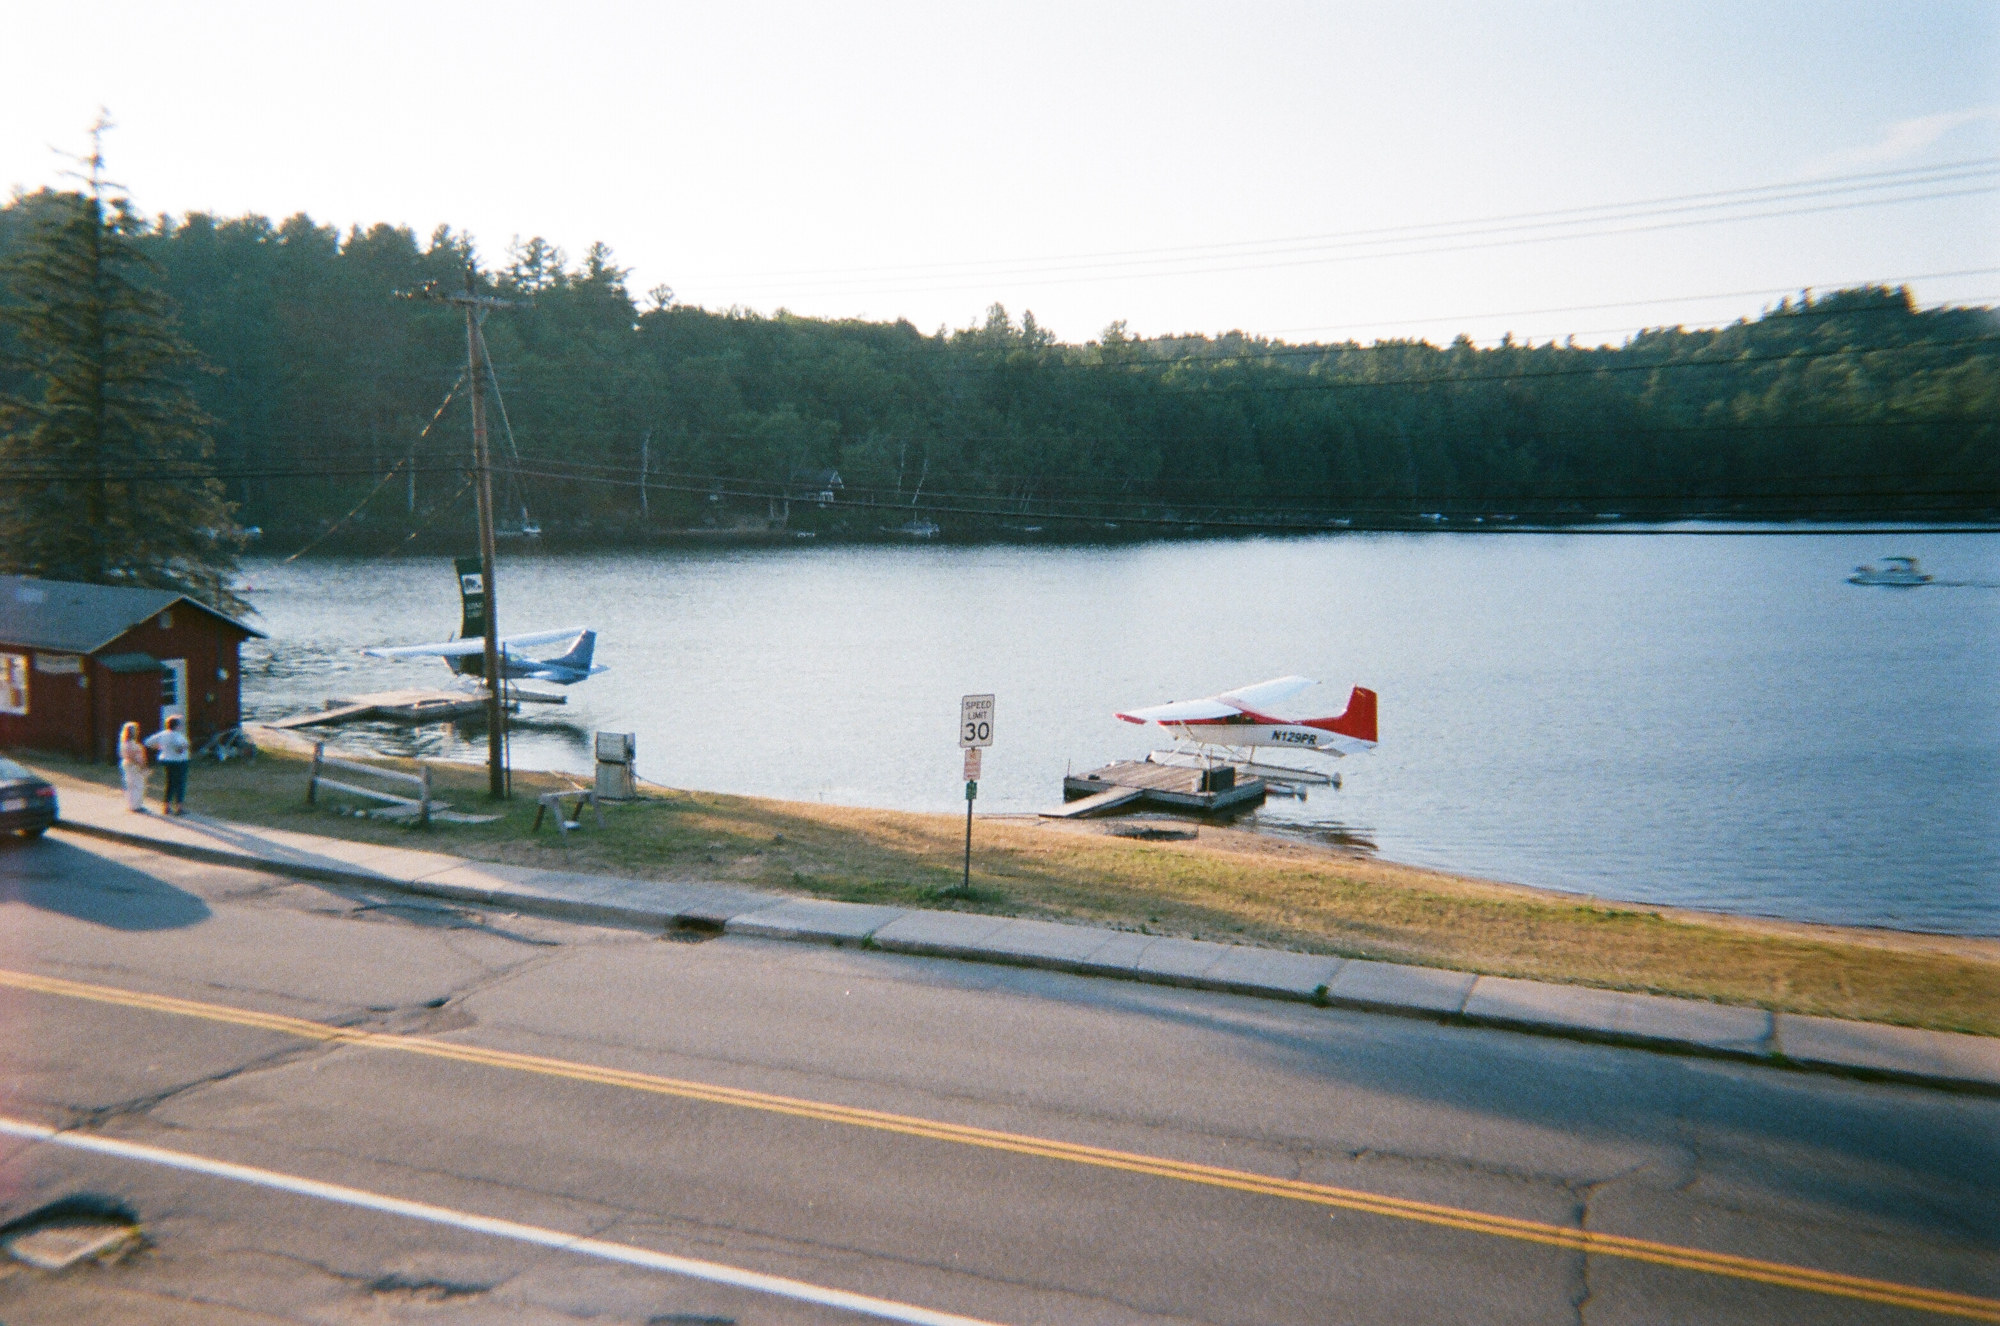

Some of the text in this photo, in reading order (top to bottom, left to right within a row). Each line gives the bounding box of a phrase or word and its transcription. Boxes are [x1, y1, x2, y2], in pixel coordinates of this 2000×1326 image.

[965, 700, 992, 710] SPEED
[967, 711, 987, 720] LIMIT
[964, 722, 990, 741] 30
[1271, 730, 1317, 745] N129PR
